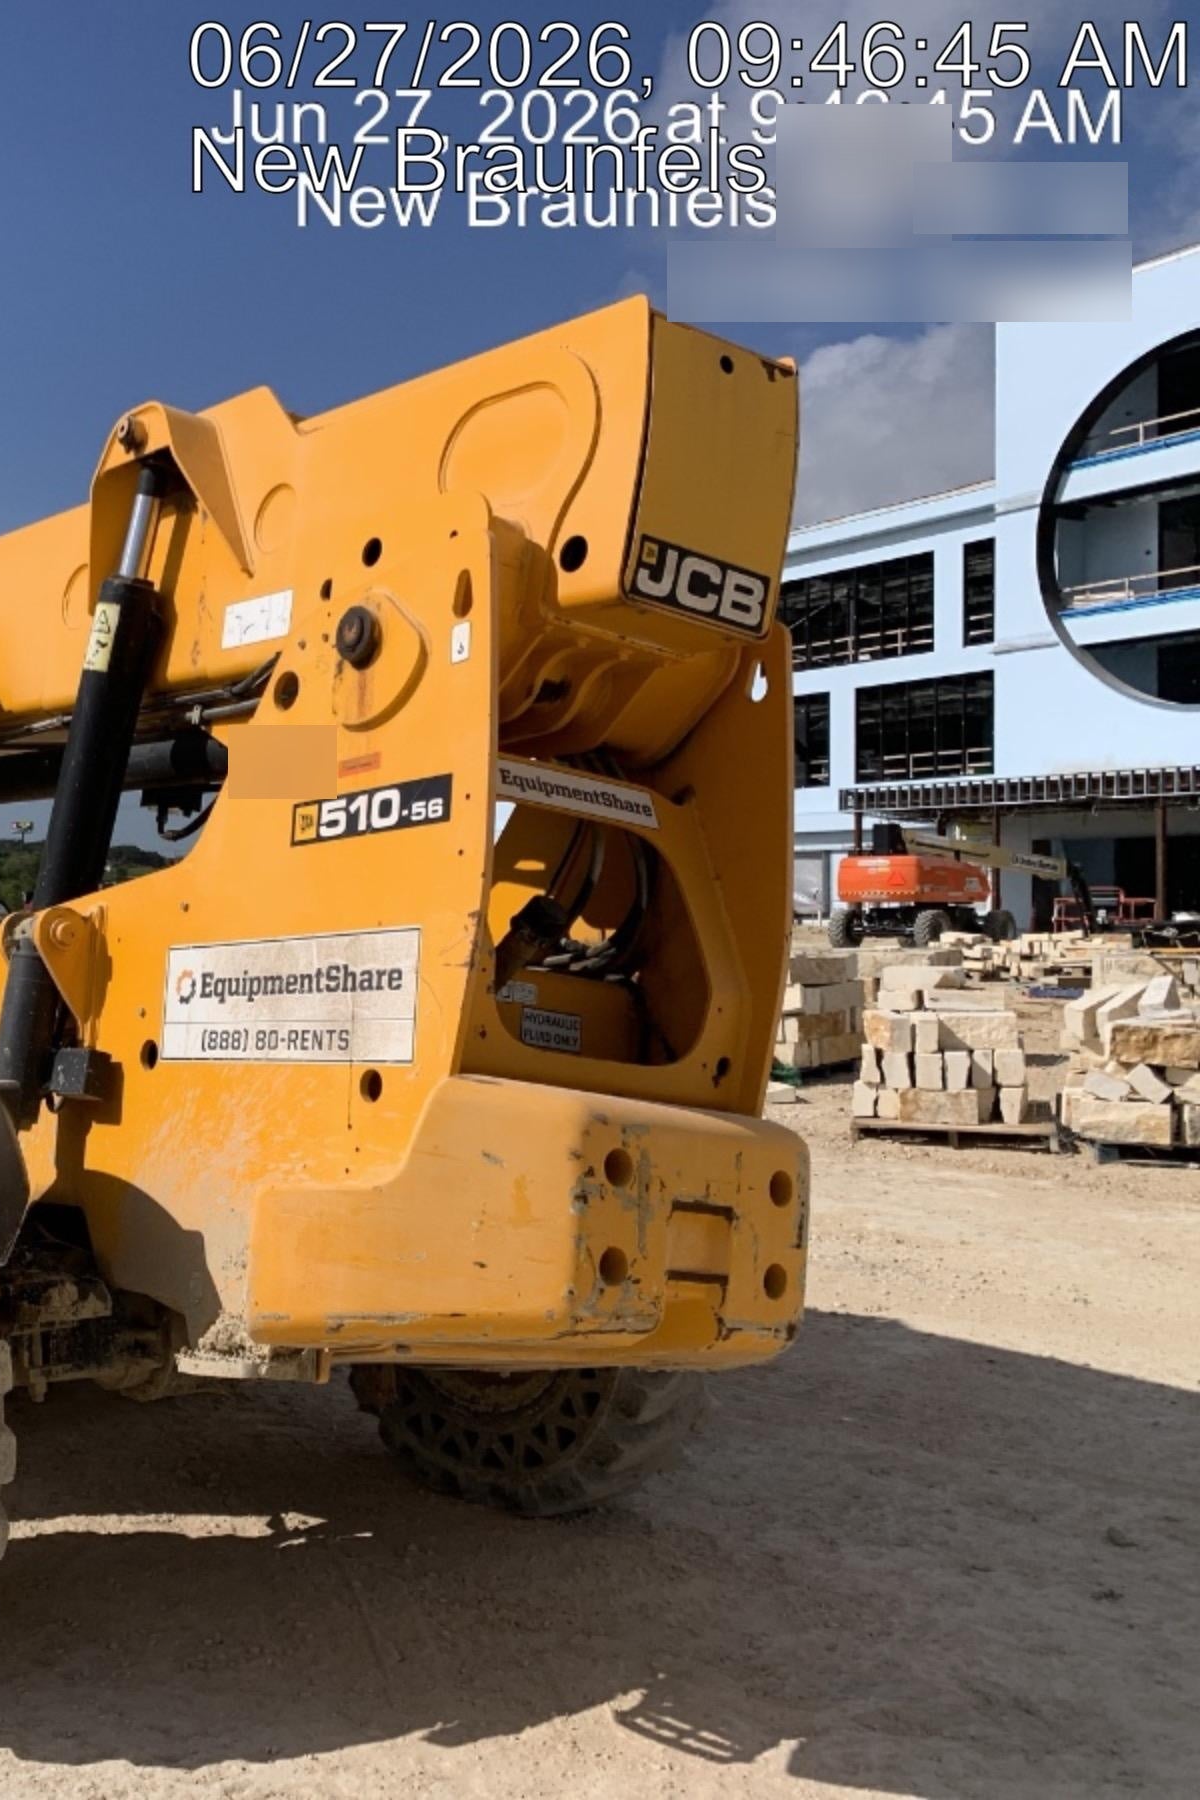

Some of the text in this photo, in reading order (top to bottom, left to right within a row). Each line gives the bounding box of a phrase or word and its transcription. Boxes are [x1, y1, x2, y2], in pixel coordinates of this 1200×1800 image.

[636, 549, 765, 627] JCB
[319, 788, 444, 837] 510-56
[499, 766, 653, 817] EquipmentShare
[200, 962, 403, 1004] EquipmentShare
[201, 1029, 350, 1052] (888) 80-RENTS
